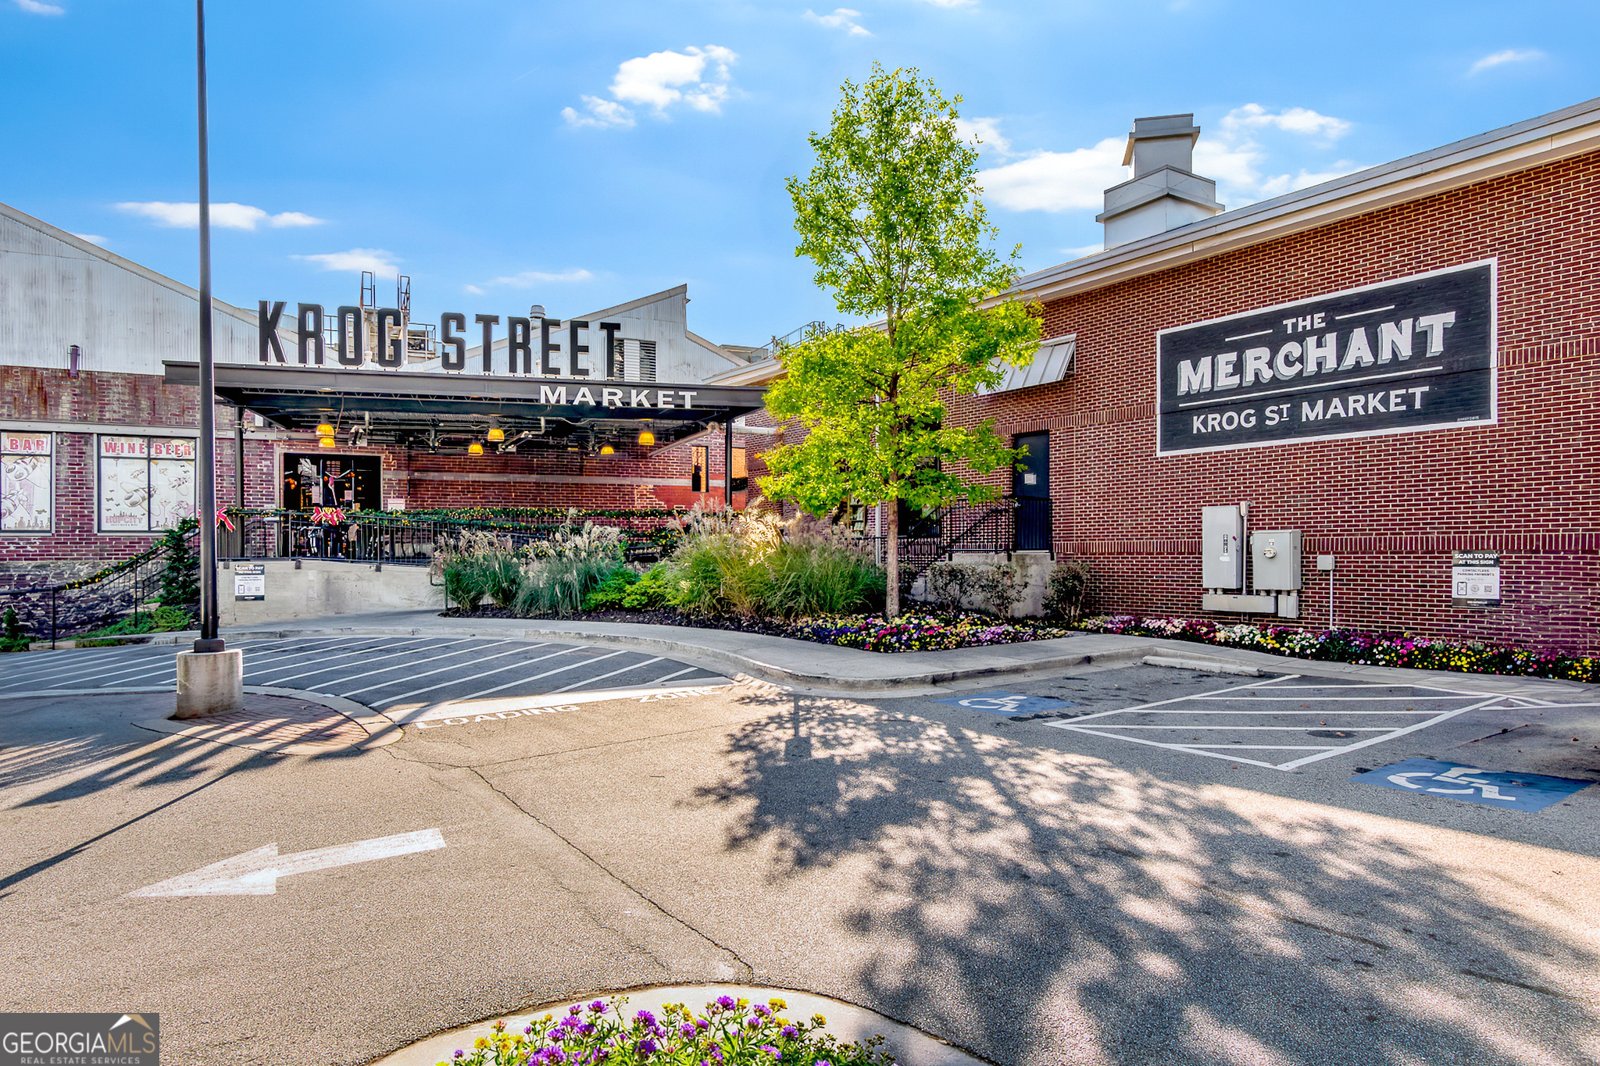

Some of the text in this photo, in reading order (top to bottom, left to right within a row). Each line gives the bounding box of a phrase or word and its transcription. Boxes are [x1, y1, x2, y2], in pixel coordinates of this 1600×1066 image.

[1283, 312, 1326, 334] THE
[258, 300, 621, 379] KROG STREET
[1177, 311, 1456, 395] MERCHANT
[539, 385, 698, 409] MARKET
[1192, 386, 1430, 434] KROG ST MARKET
[9, 438, 45, 451] BAR
[104, 442, 191, 456] WINE BEER
[416, 704, 581, 729] LOADING
